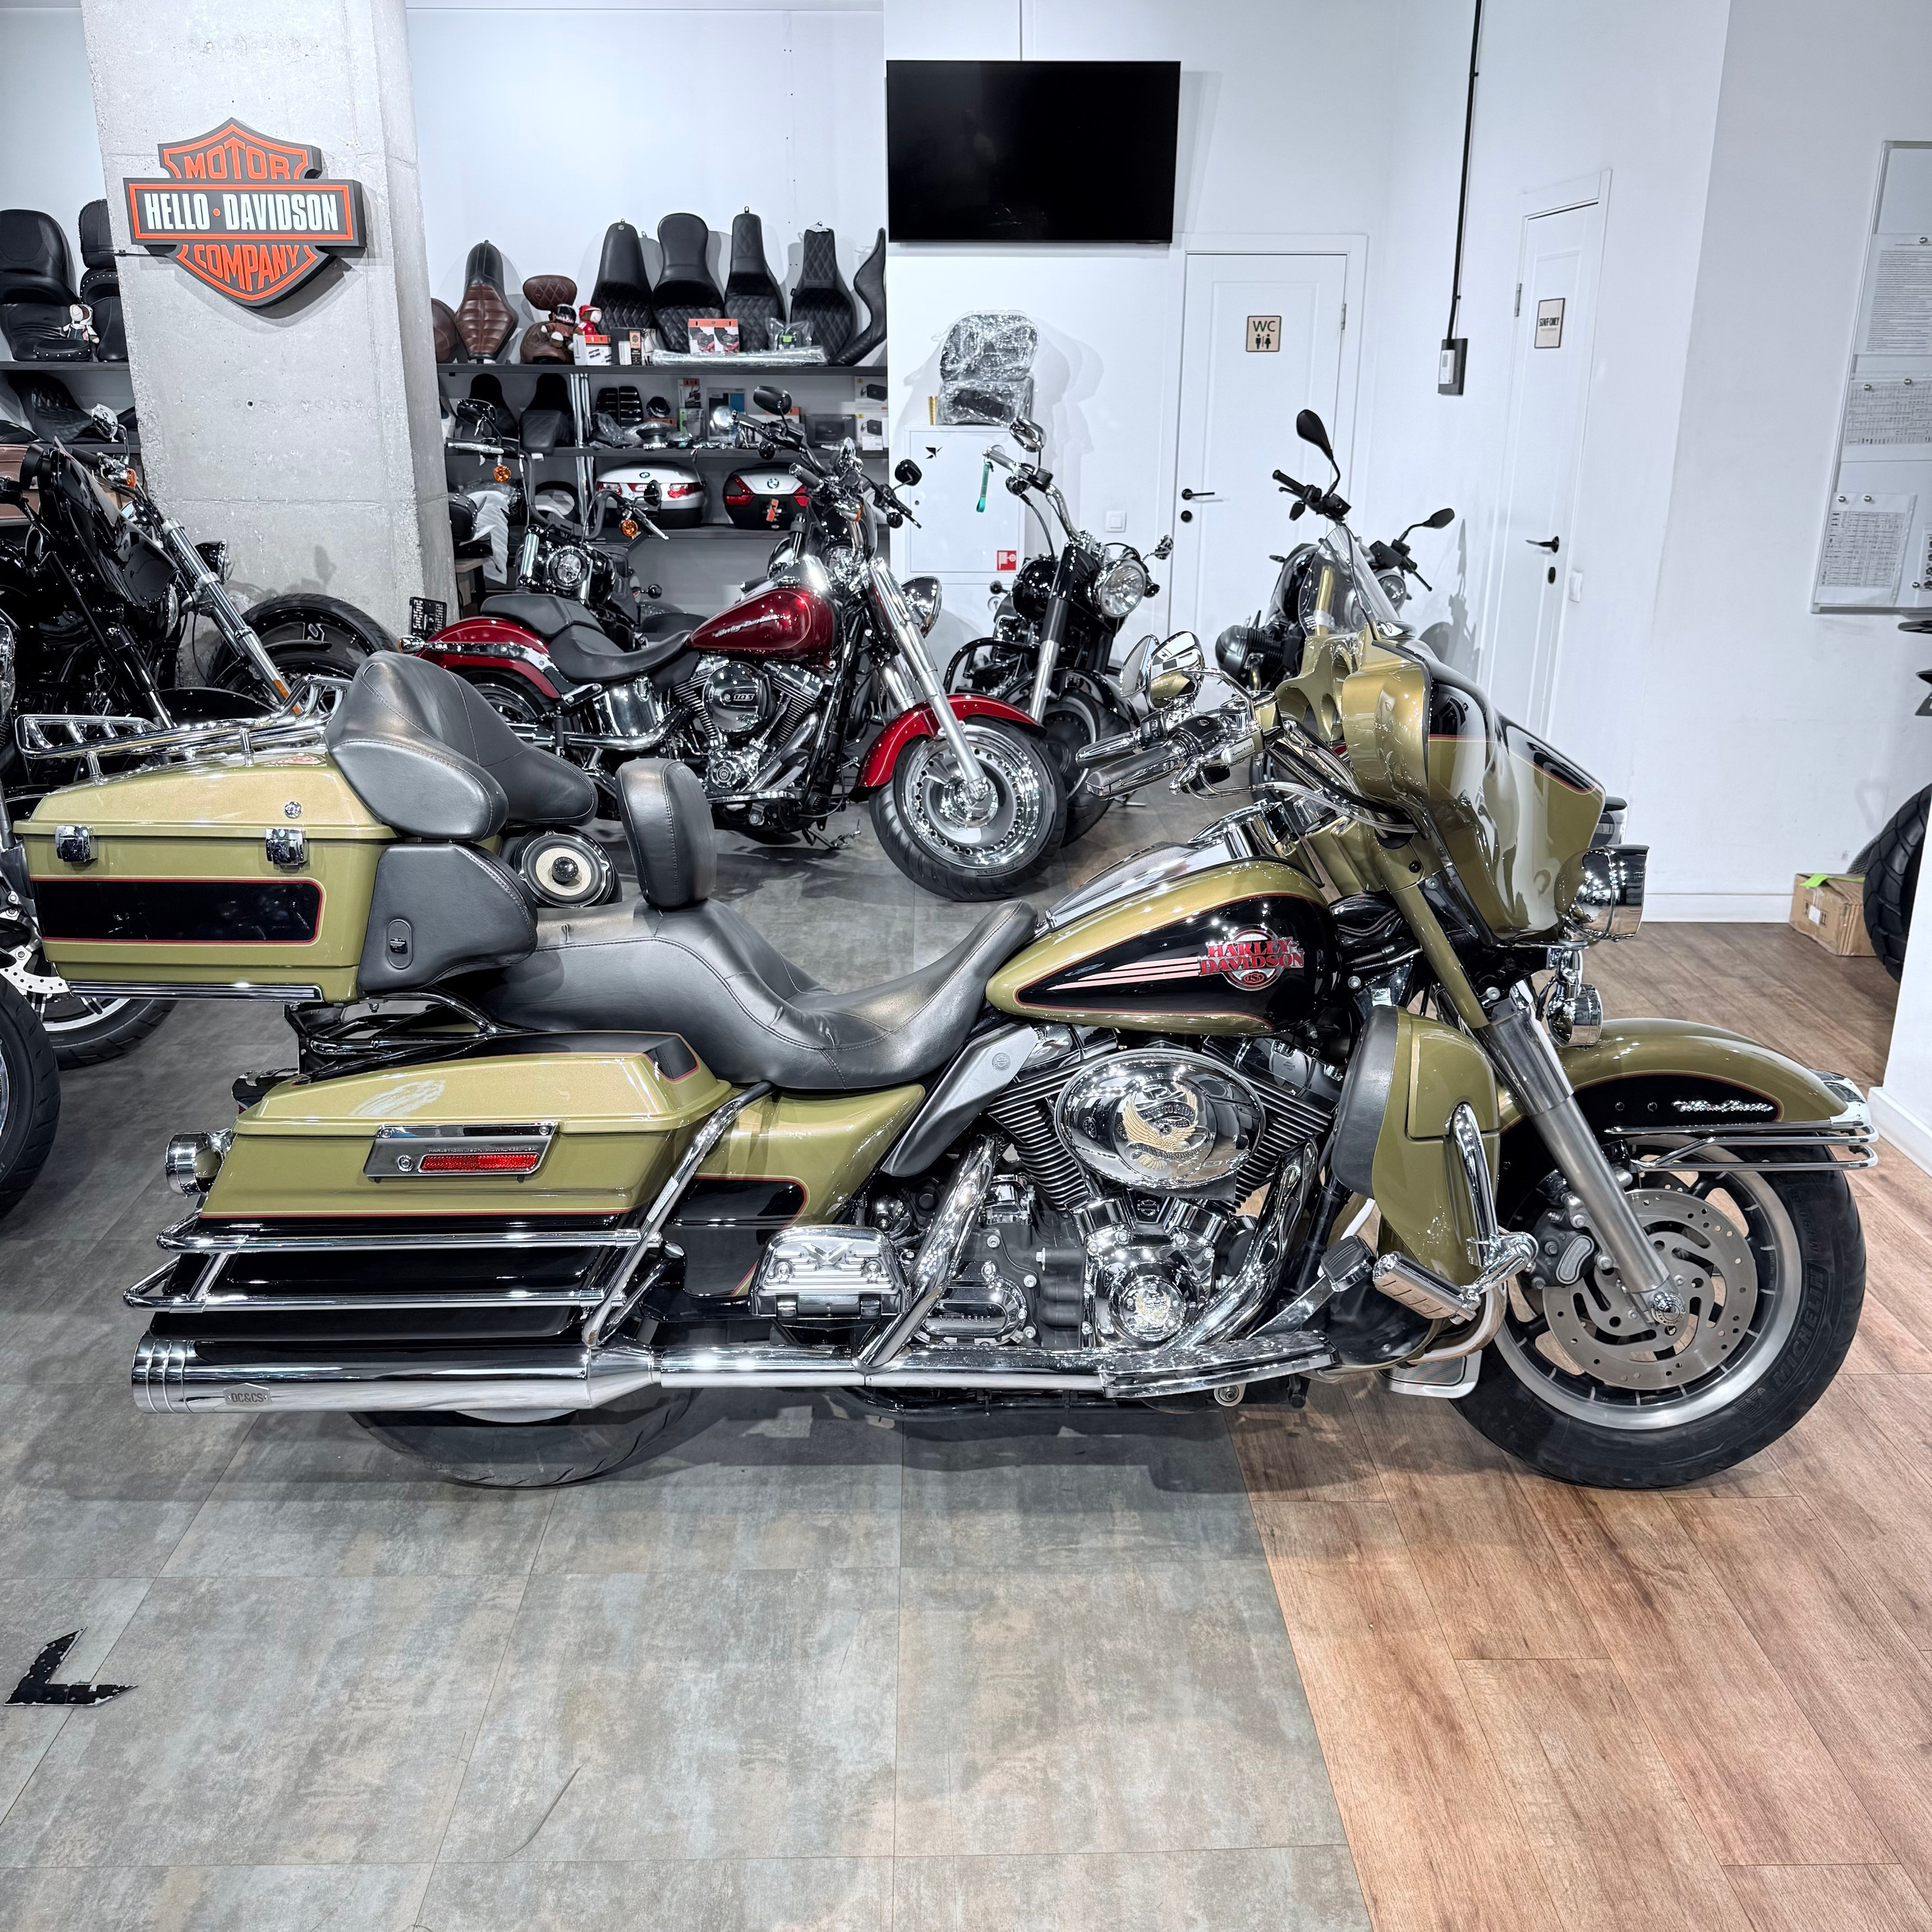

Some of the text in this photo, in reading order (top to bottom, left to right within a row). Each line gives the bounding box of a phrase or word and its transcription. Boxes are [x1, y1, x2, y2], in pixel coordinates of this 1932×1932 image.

[184, 137, 291, 180] MOTOR
[144, 193, 338, 231] HELLO DAVIDSON
[193, 244, 299, 291] COMPANY
[1253, 320, 1276, 332] WC
[1200, 952, 1303, 975] DAVIDSON
[1208, 939, 1291, 958] HARLEY
[1772, 1269, 1824, 1388] MICHELIN
[231, 1392, 264, 1403] DC&CS
